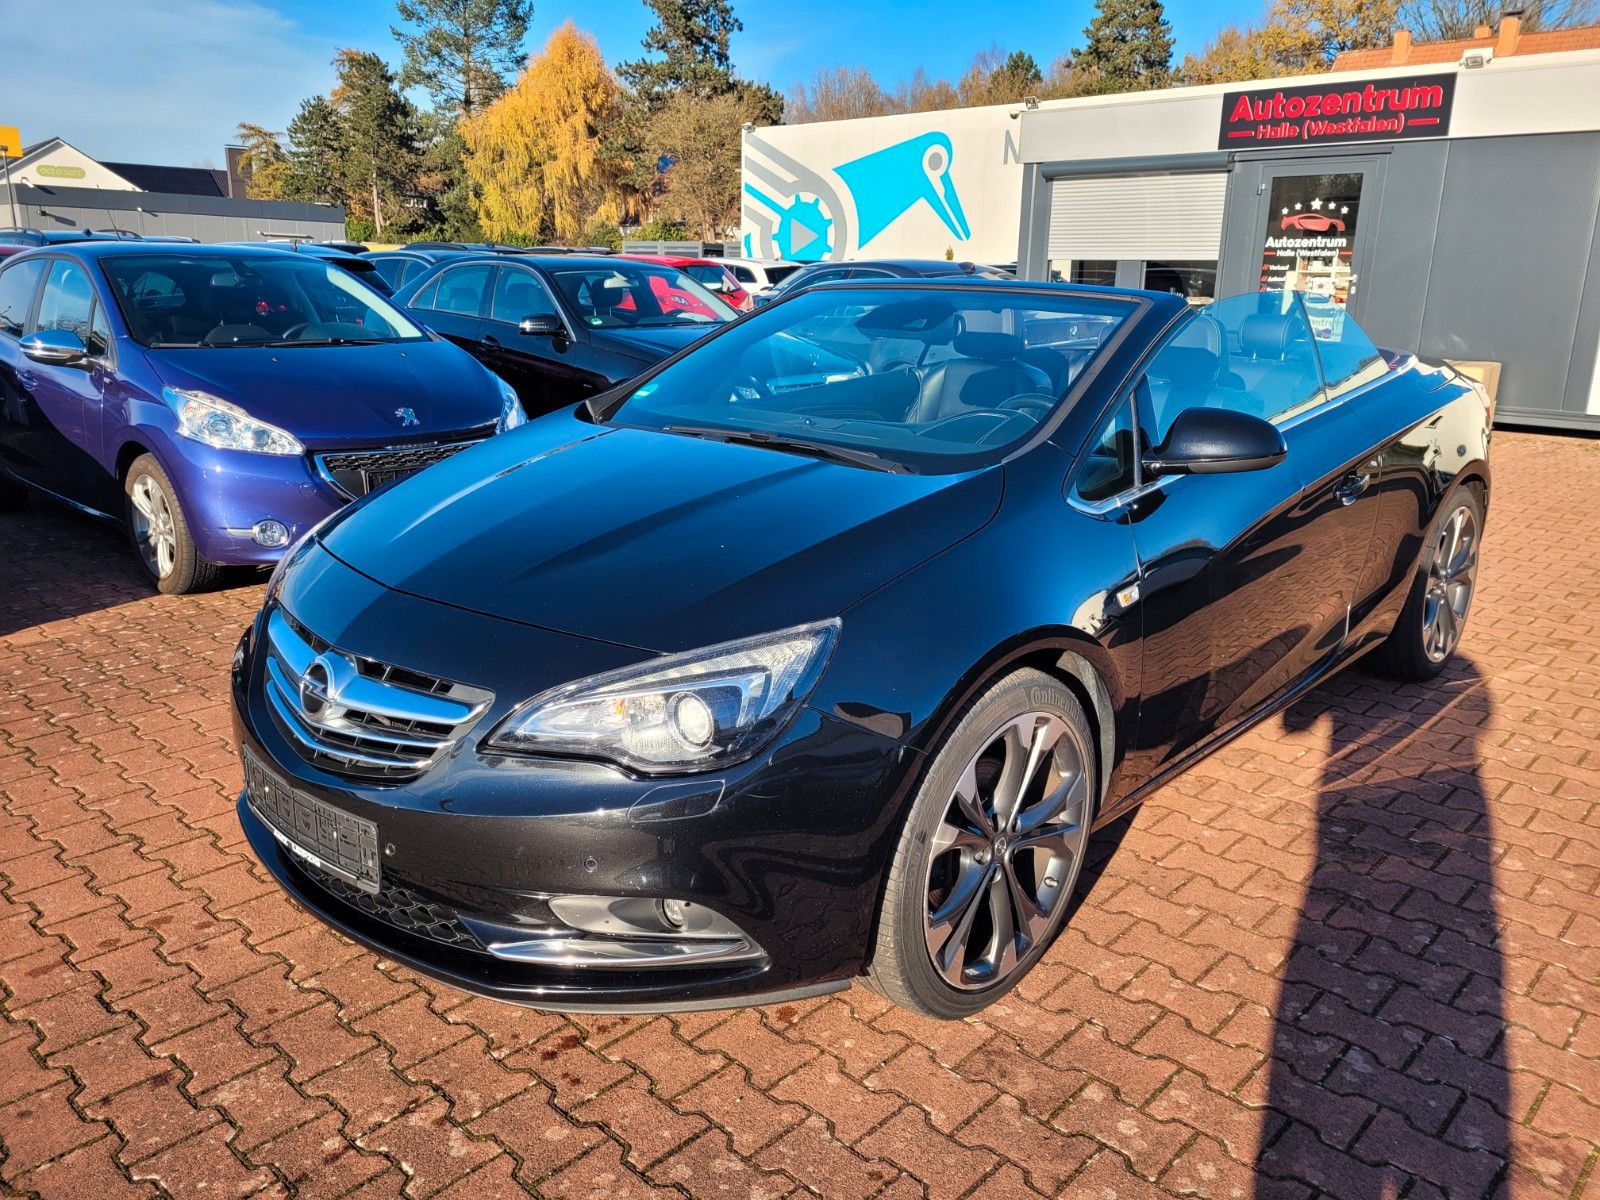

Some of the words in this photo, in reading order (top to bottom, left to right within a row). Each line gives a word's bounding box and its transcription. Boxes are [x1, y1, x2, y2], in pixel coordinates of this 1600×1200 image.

[1229, 84, 1443, 123] Autozentrum
[1256, 122, 1300, 140] Halle
[1302, 113, 1405, 140] (Westfalen)
[1265, 236, 1346, 248] Autozentrum
[1276, 249, 1295, 257] Halle
[1296, 248, 1339, 257] (Westfalen)
[1031, 687, 1080, 720] Continental
